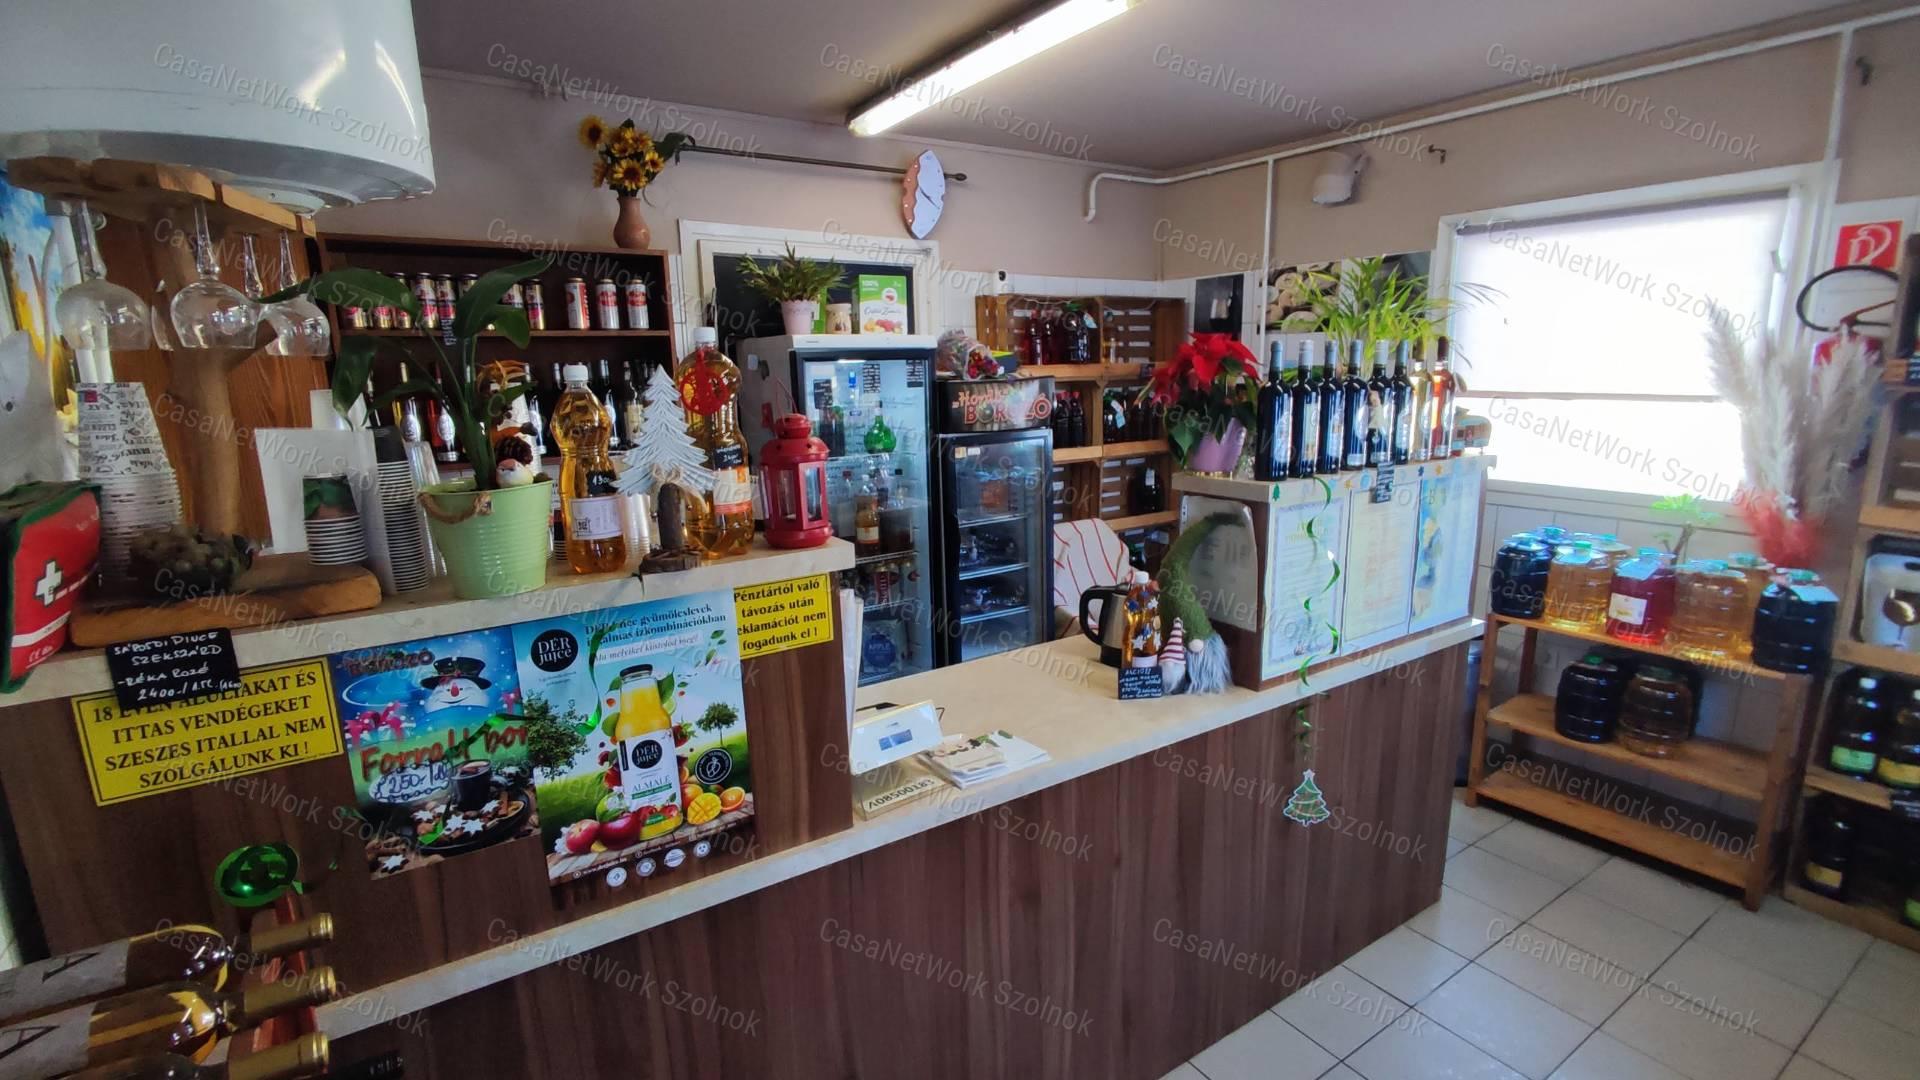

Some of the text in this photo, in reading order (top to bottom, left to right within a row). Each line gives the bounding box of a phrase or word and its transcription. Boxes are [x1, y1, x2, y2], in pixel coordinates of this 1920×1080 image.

[734, 578, 820, 602] Pénztártól való
[742, 596, 814, 618] távozás után
[737, 611, 826, 635] eklamációt nem
[743, 632, 797, 651] fogadunk
[801, 628, 810, 638] el
[131, 644, 222, 666] SZEKSZÁRD
[93, 705, 113, 723] 18
[296, 671, 317, 687] ÉS
[112, 694, 312, 744] ITTAS VENDÉGEKET
[105, 716, 327, 771] SZESZES ITALLAL NEM
[139, 747, 276, 788] SZOLGÁLUNK
[279, 742, 300, 758] KI
